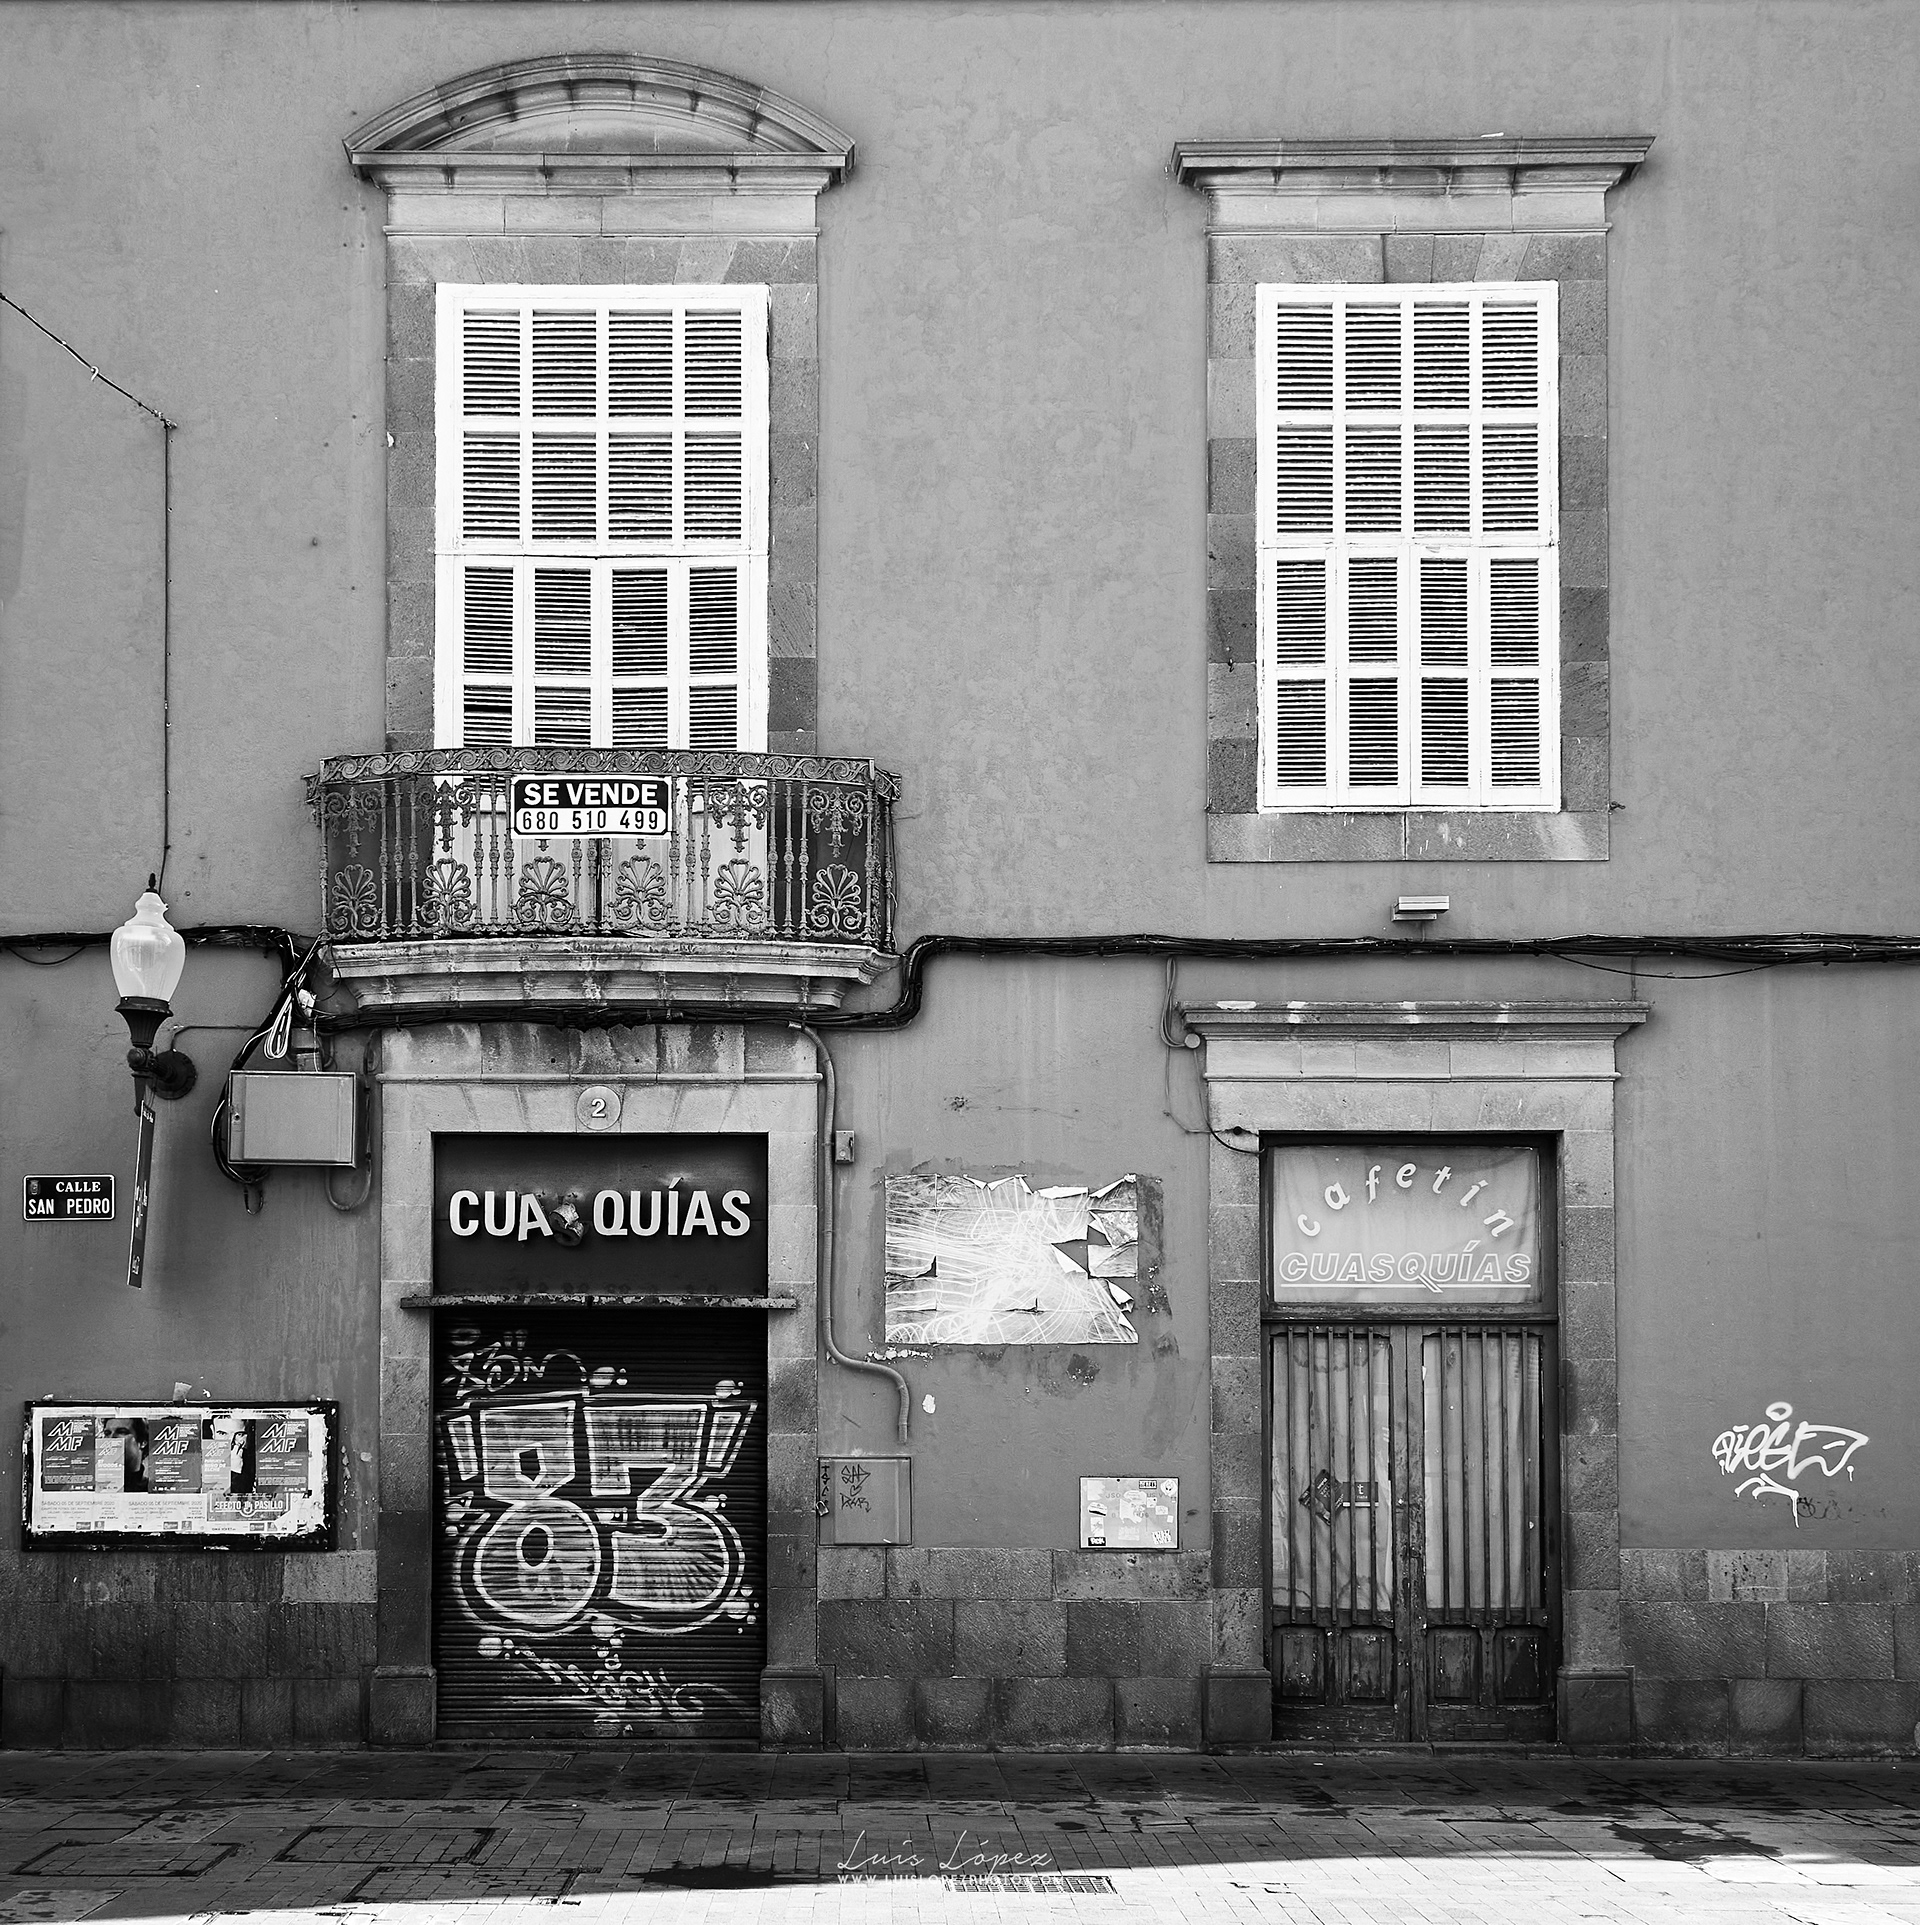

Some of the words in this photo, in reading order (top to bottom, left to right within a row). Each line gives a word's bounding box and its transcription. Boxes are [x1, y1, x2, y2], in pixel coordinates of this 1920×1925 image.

[523, 783, 560, 806] SE
[565, 783, 658, 806] VENDE
[522, 811, 559, 830] 680
[572, 810, 607, 829] 510
[619, 809, 658, 830] 499
[590, 1098, 607, 1119] 2
[55, 1181, 101, 1193] CALLE
[28, 1199, 55, 1215] SAN
[66, 1198, 110, 1214] PEDRO
[1279, 1240, 1531, 1293] CUASQUÍAS
[254, 1500, 283, 1511] PASILLO
